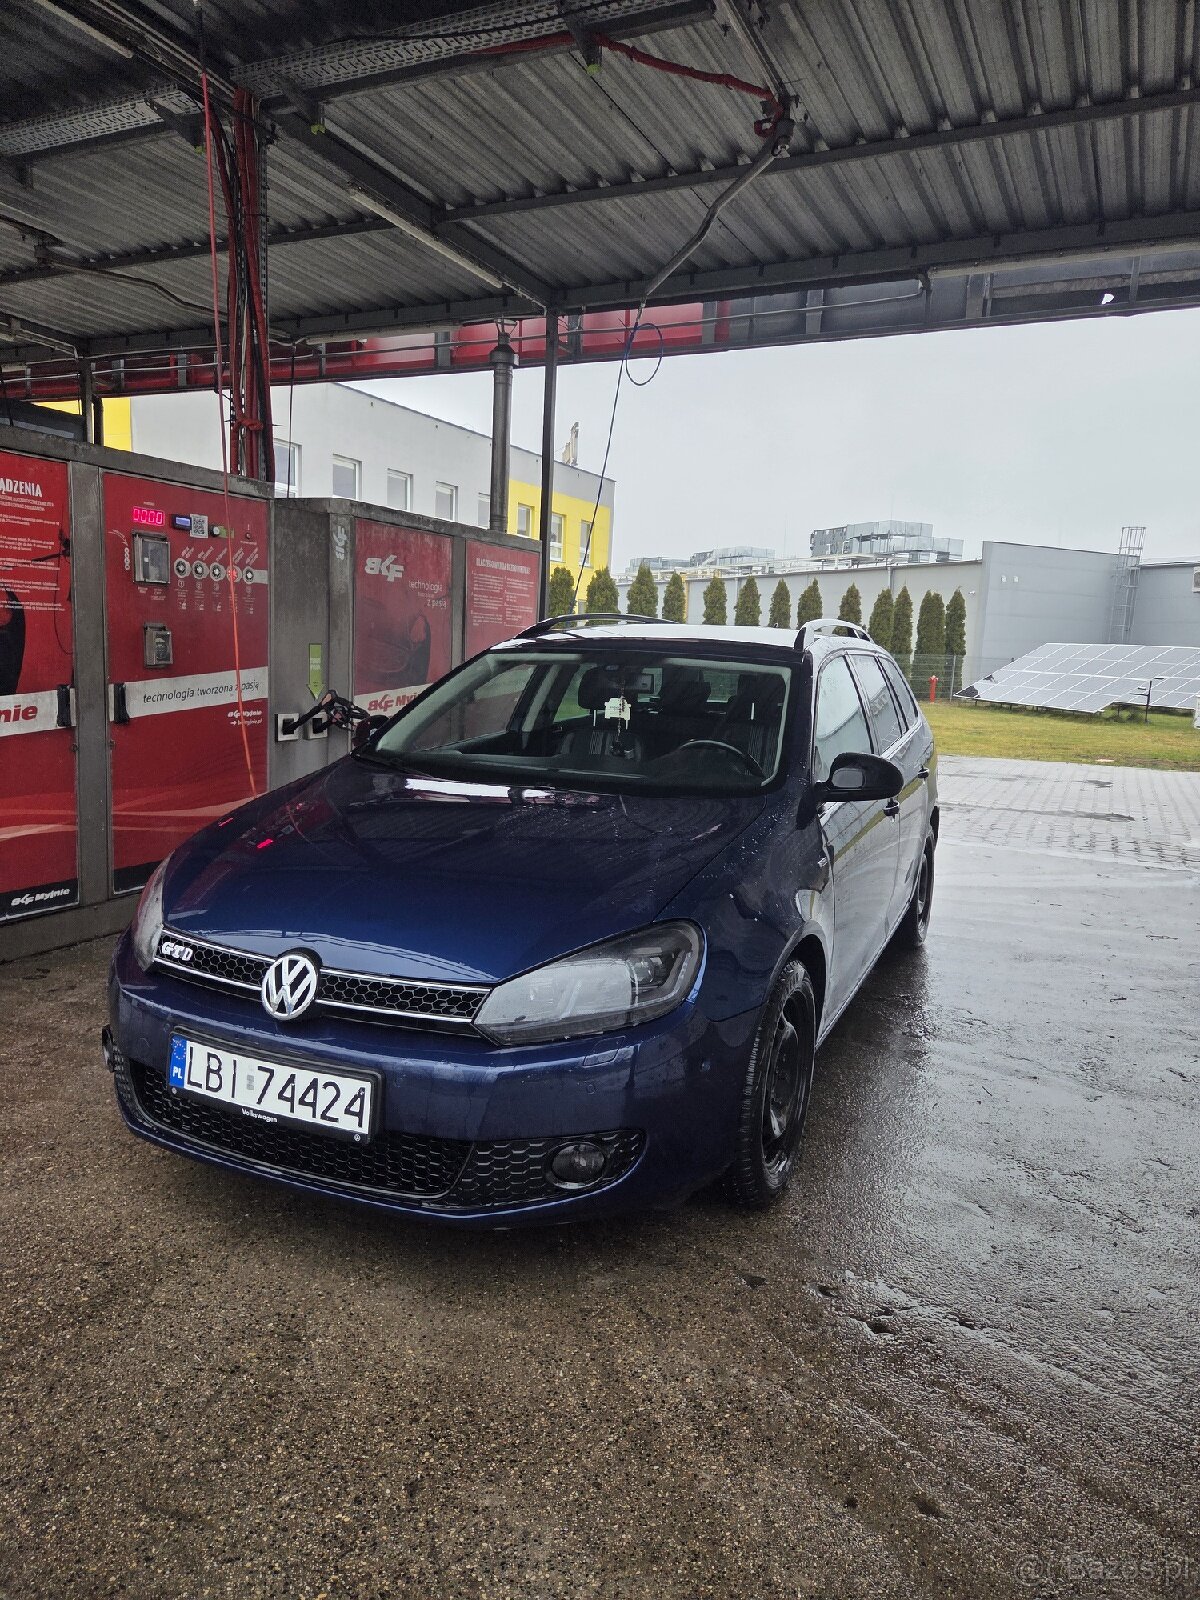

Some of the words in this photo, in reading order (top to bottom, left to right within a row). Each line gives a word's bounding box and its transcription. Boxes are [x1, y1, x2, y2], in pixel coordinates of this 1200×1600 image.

[365, 554, 404, 582] BKF
[143, 687, 195, 704] technologia
[162, 941, 193, 961] GTD
[172, 1065, 183, 1079] PL
[186, 1046, 237, 1098] LBI
[256, 1065, 366, 1128] 74424
[241, 1107, 278, 1123] Volkswagen
